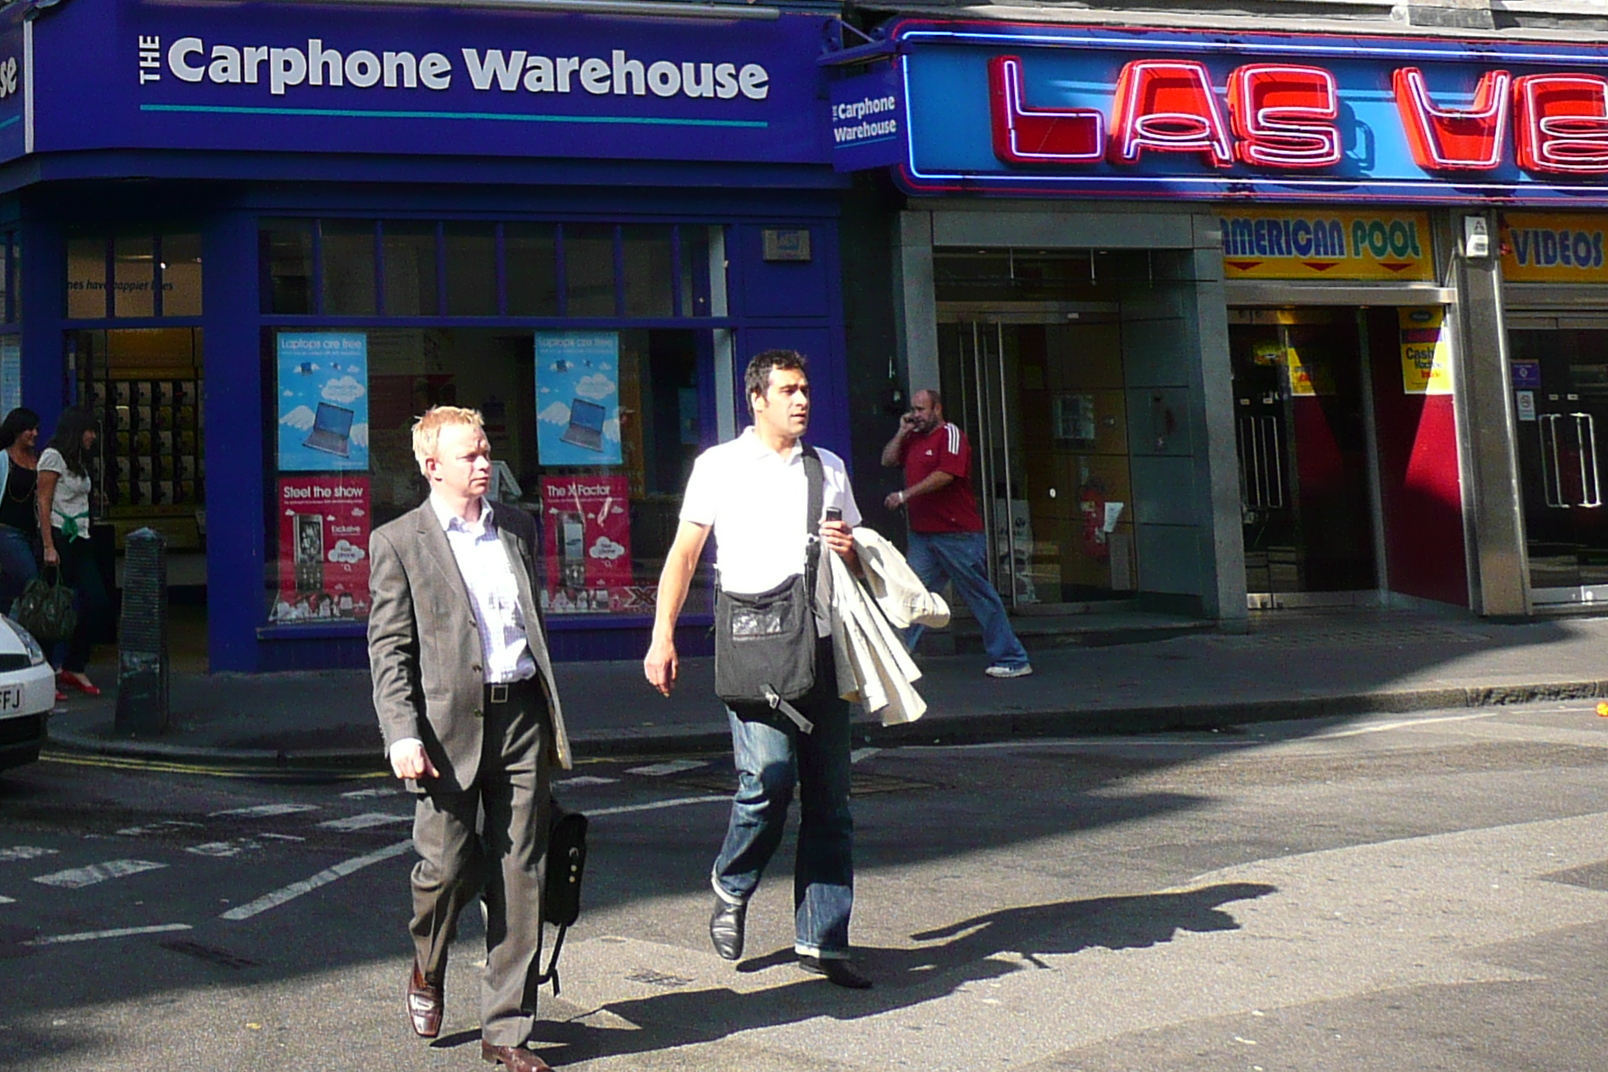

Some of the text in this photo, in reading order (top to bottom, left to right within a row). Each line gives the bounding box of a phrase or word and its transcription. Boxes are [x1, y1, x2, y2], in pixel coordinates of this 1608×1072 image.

[139, 35, 769, 100] THE Carphone Warehouse
[838, 96, 896, 119] Carphone
[988, 54, 1341, 168] LAS
[834, 119, 897, 143] Warehouse
[1351, 219, 1422, 259] POOL
[1509, 227, 1603, 269] VIDEOS
[281, 339, 321, 349] Laptops
[283, 486, 363, 498] Steel the show
[547, 485, 566, 496] The
[577, 484, 610, 495] Factor
